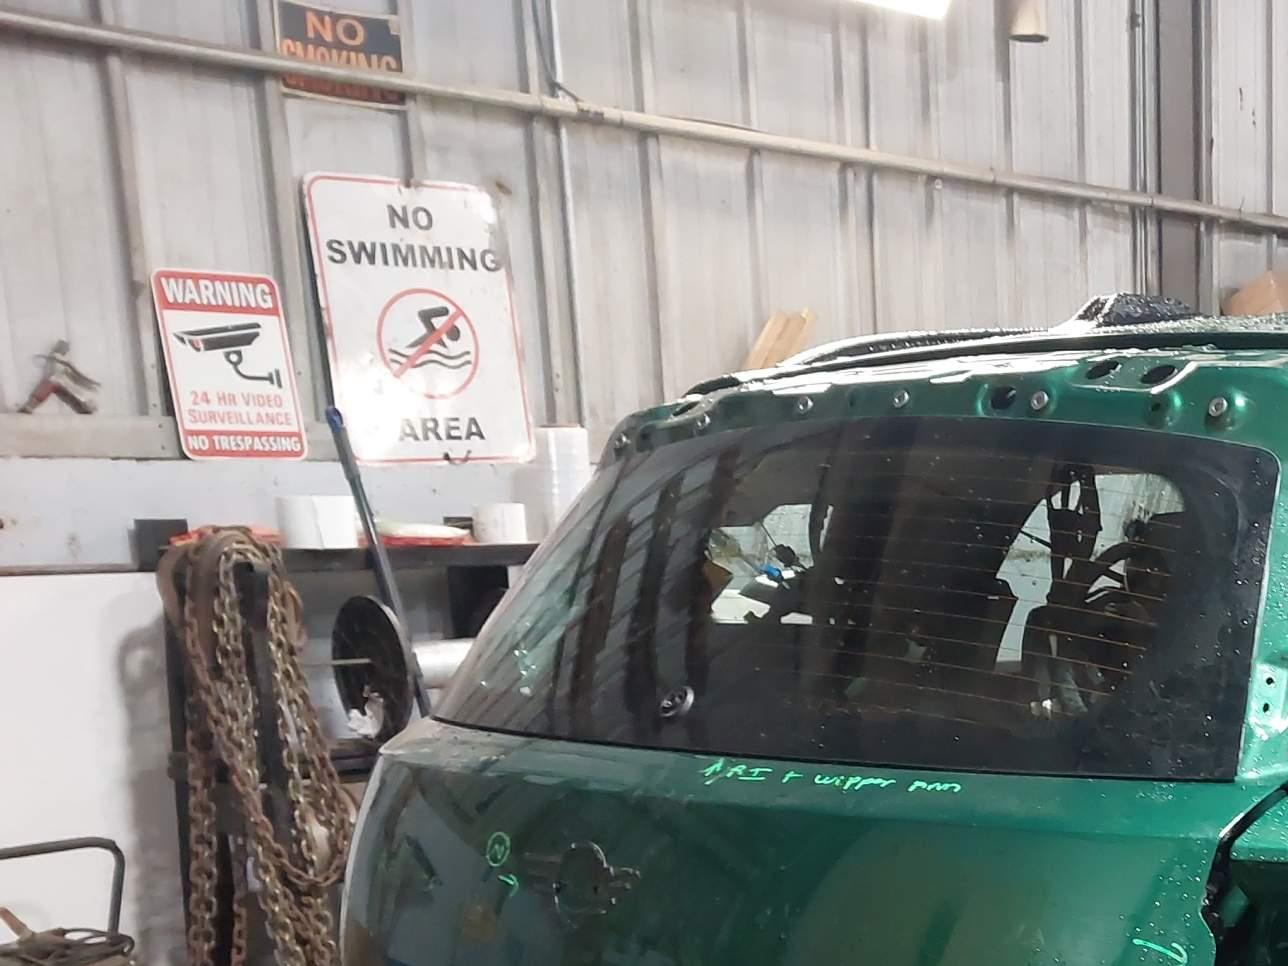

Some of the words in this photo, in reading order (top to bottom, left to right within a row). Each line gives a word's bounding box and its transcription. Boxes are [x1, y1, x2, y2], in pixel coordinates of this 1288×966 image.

[305, 9, 365, 46] NO
[387, 204, 433, 231] NO
[326, 239, 503, 272] SWIMMING
[160, 276, 273, 309] WARNING
[190, 389, 211, 406] 24
[217, 391, 237, 407] HR
[240, 392, 283, 409] VIDEO
[188, 408, 293, 426] SURVEILLANCE
[398, 416, 487, 442] AREA
[187, 434, 209, 450] NO
[213, 434, 301, 453] TRESPASSING
